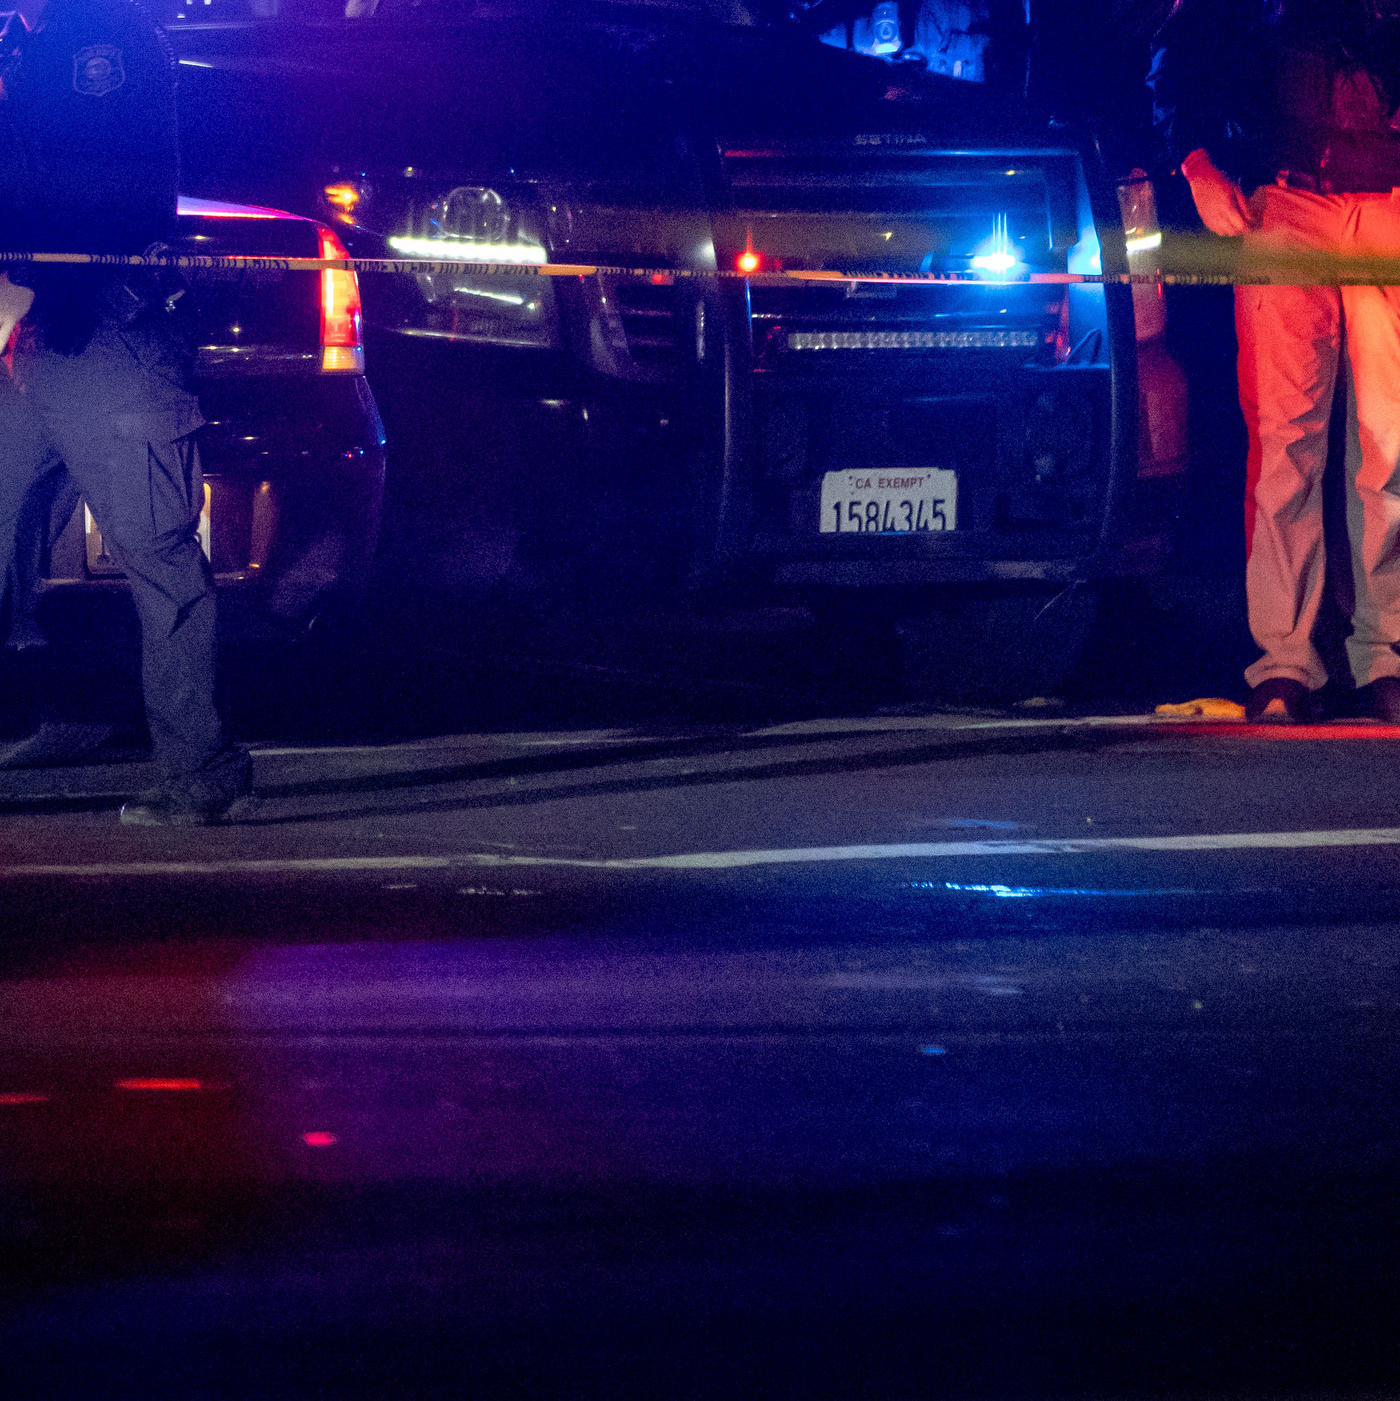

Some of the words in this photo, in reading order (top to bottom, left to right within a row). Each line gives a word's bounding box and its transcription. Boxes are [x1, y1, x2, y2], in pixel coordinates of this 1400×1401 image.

[855, 477, 872, 490] CA
[877, 476, 925, 489] EXEMPT
[832, 498, 947, 533] 1584345
